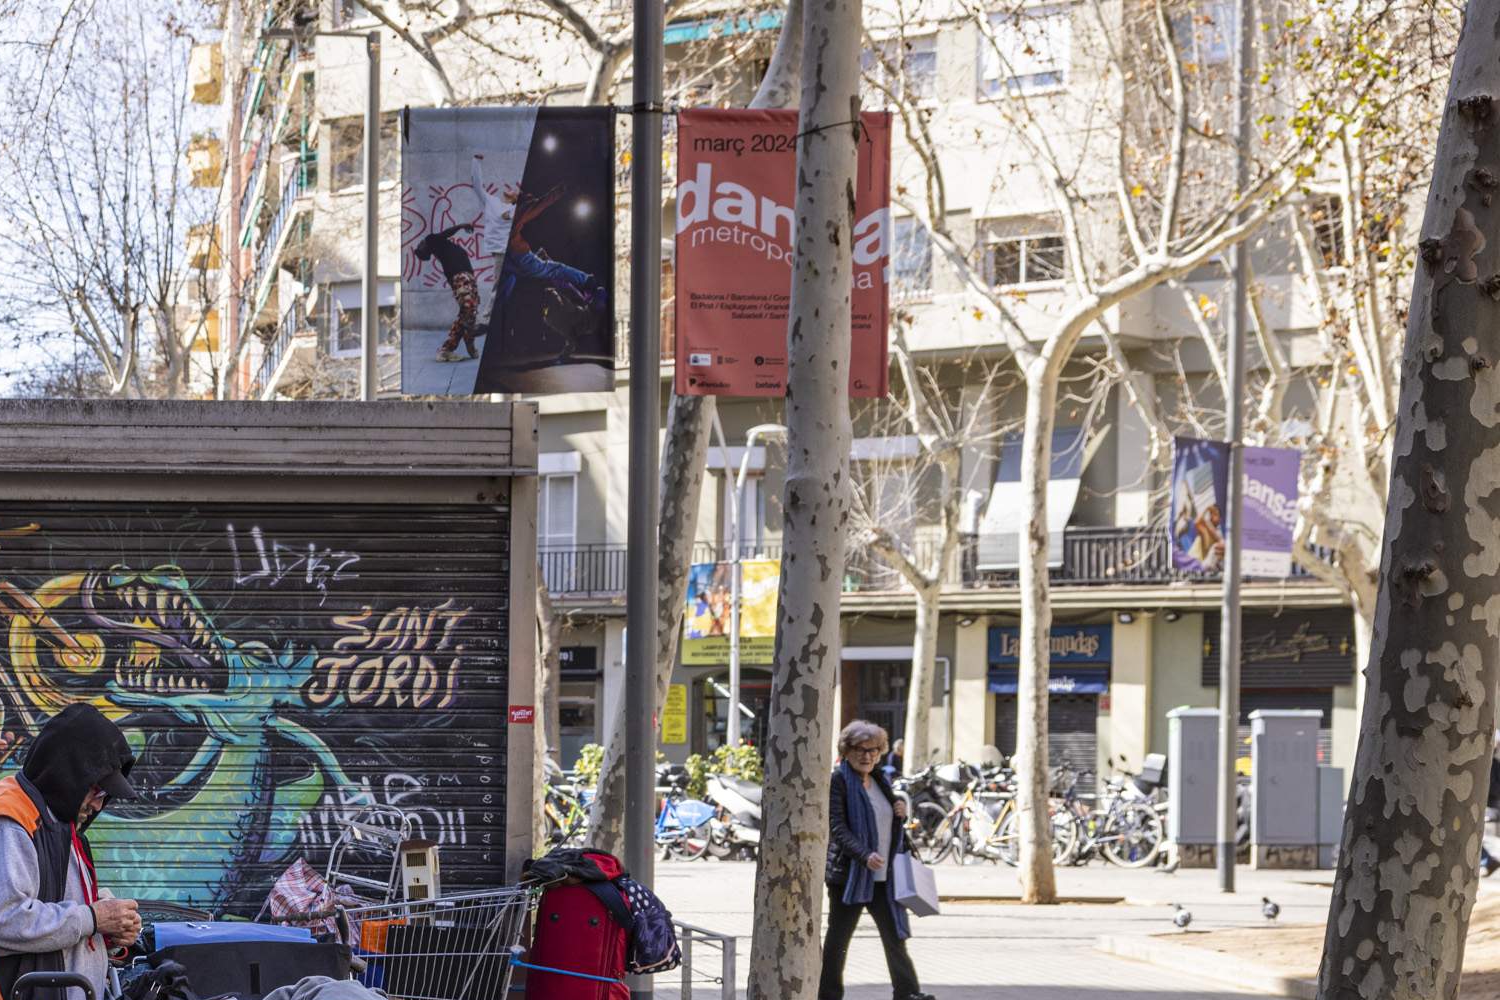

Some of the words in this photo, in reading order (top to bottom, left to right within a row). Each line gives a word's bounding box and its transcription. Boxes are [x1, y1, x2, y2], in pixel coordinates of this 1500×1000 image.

[693, 138, 745, 157] març
[751, 134, 798, 153] 2024
[677, 162, 889, 266] dana
